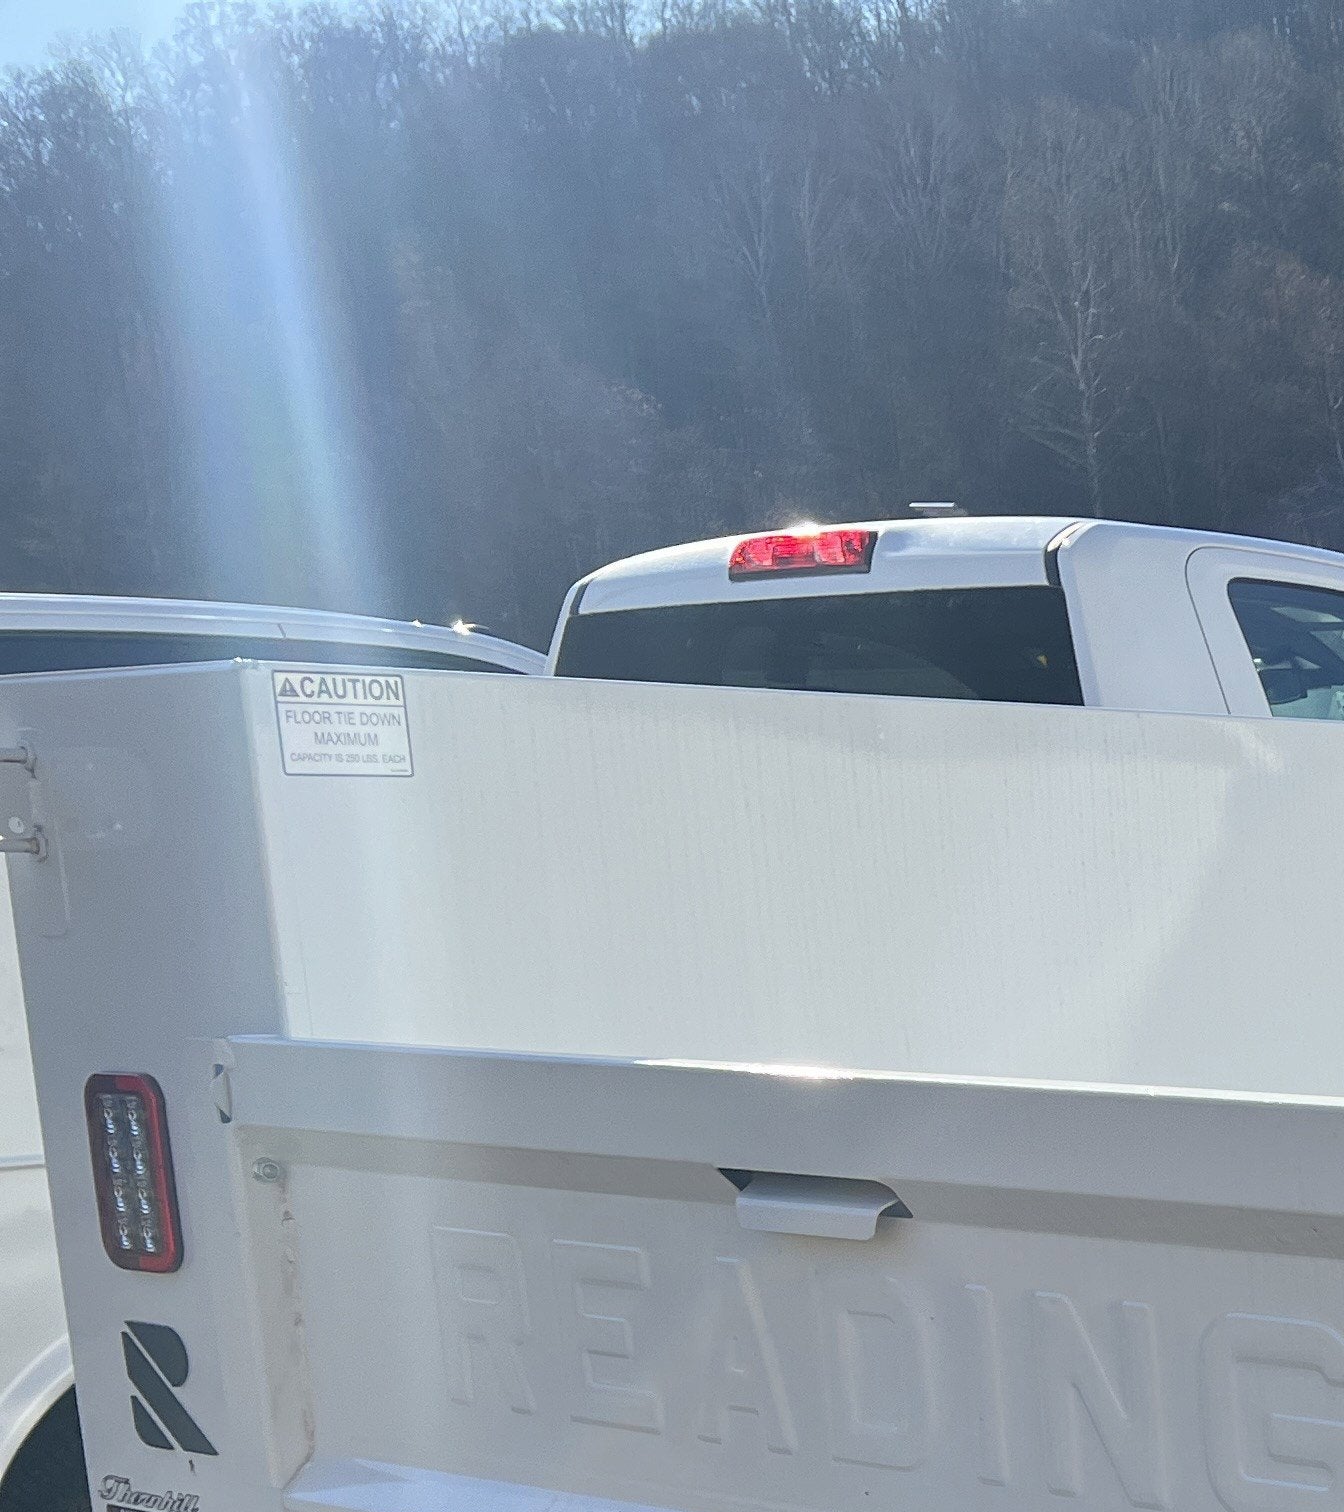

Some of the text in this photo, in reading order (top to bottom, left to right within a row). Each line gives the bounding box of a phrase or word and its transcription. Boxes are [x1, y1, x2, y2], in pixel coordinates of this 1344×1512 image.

[300, 676, 401, 701] CAUTION
[285, 710, 402, 727] FLOOR TIE DOWN
[314, 731, 380, 746] MAXIMUM
[290, 753, 333, 763] CAPACITY
[334, 754, 344, 763] IS
[382, 754, 406, 764] EACH
